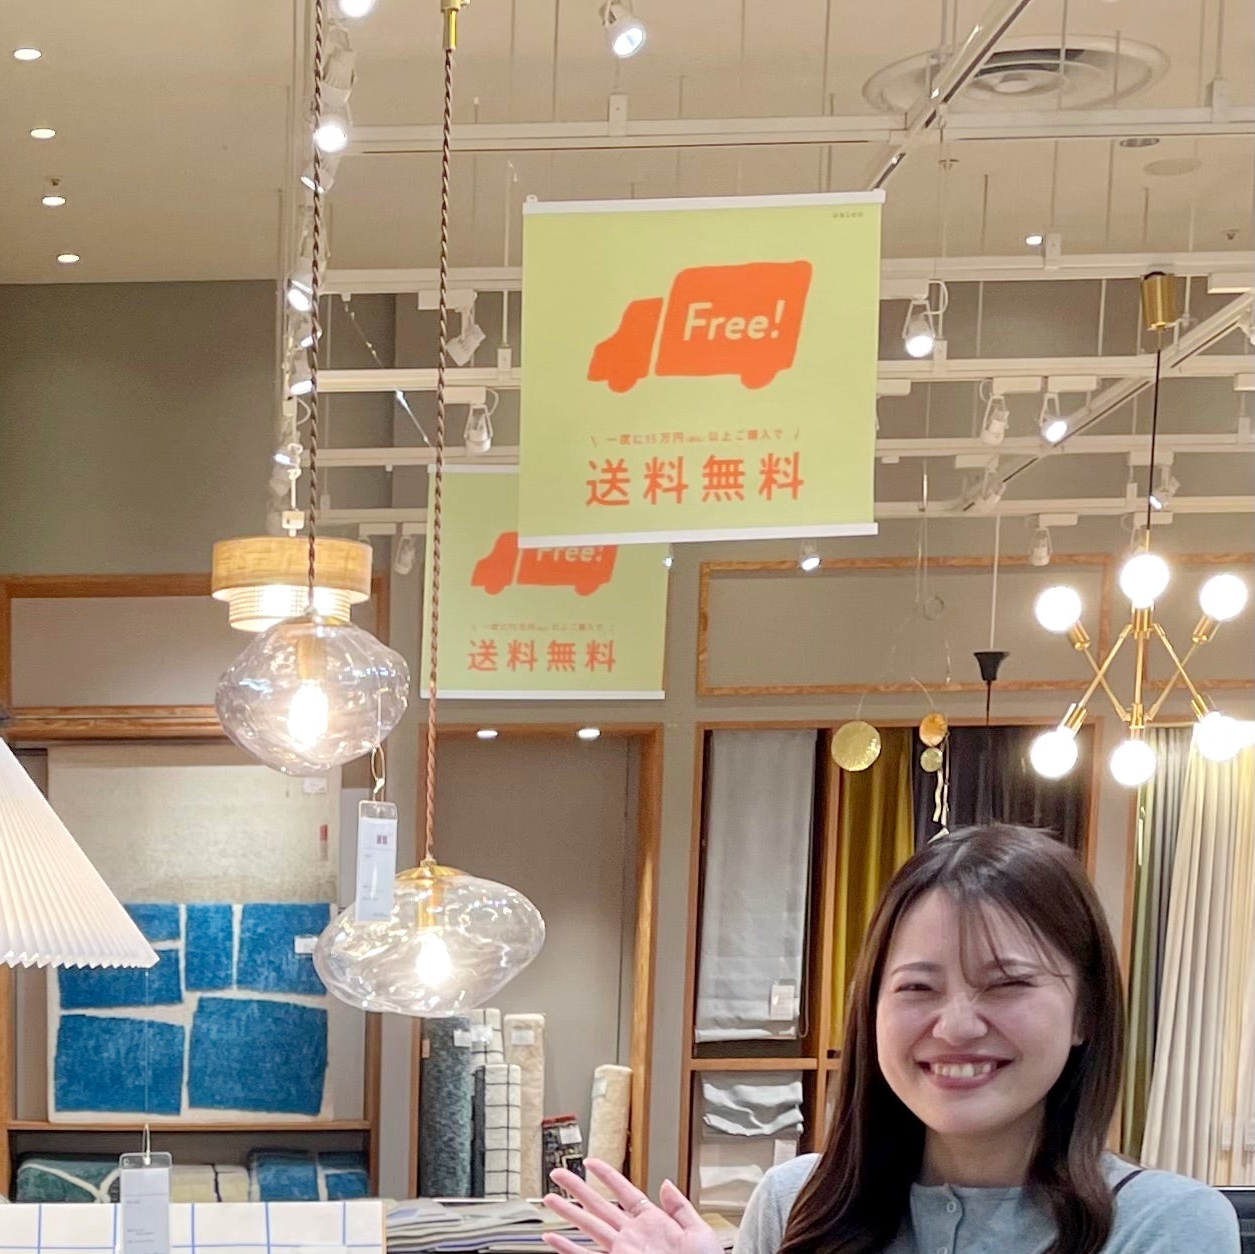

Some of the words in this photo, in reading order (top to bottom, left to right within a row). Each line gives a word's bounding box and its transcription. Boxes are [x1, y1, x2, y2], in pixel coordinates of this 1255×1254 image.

[683, 299, 786, 341] Free!
[586, 452, 805, 506] 送料無料
[468, 639, 617, 672] 送料無料
